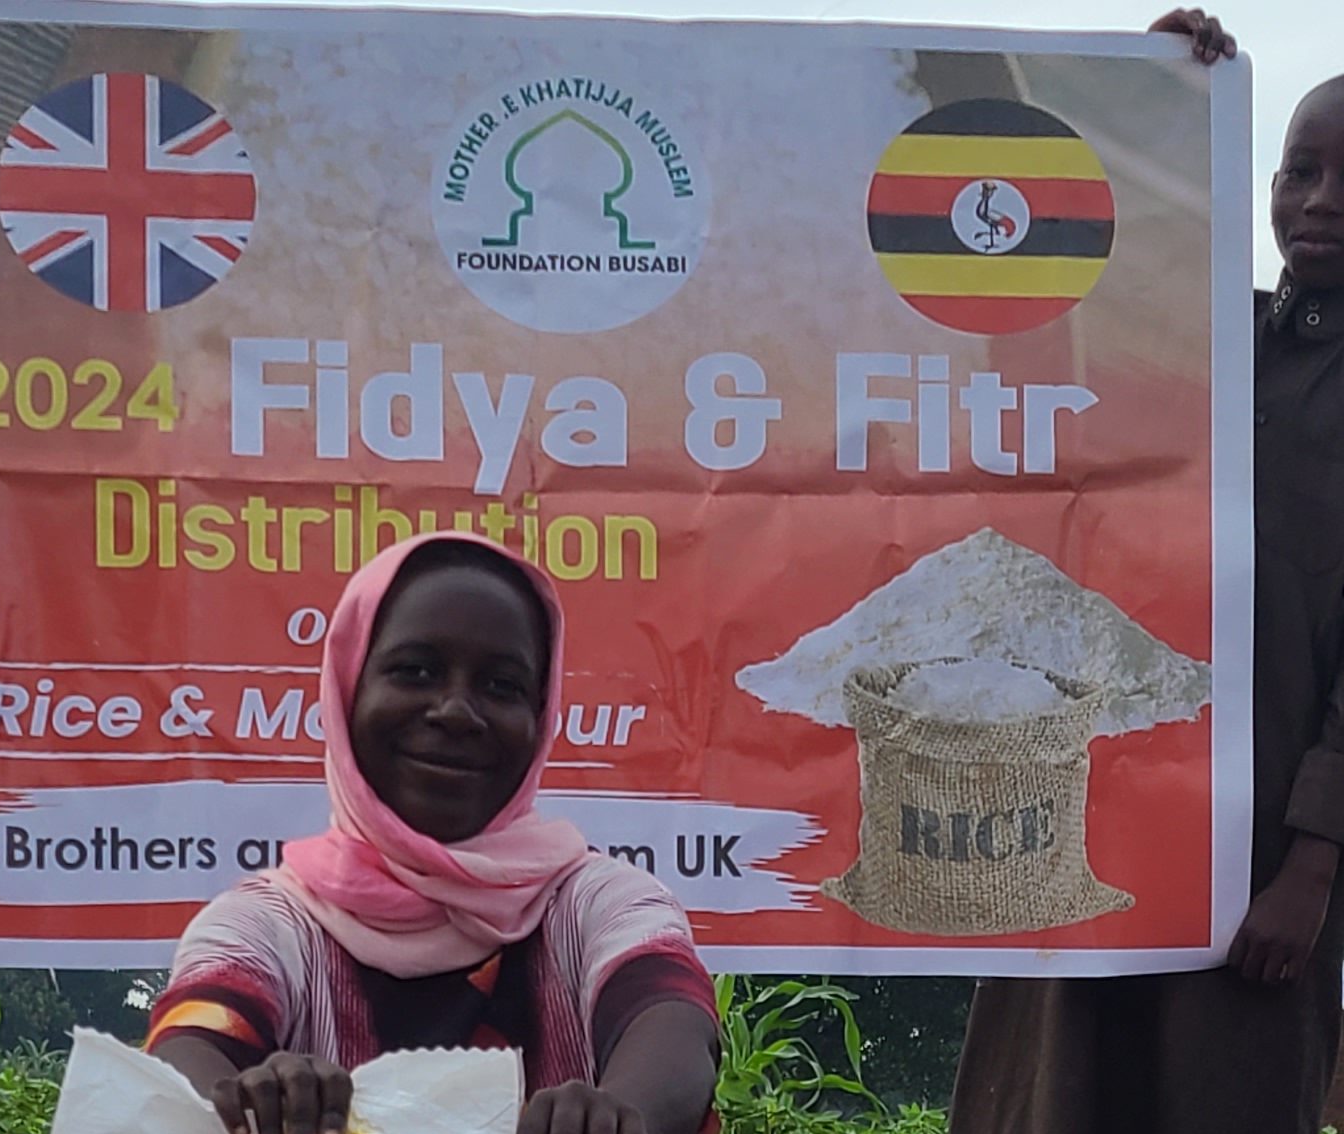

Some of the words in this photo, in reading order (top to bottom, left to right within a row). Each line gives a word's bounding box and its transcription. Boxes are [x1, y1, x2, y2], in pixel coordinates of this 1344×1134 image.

[443, 111, 499, 202] MOTHER
[519, 77, 634, 118] KHATIJJA
[634, 110, 694, 199] MUSLEM
[456, 252, 601, 272] FOUNDATION
[608, 256, 687, 274] BUSABI
[231, 337, 628, 495] Fidya
[684, 352, 782, 470] &
[836, 353, 1099, 477] Fitr
[287, 607, 327, 646] o
[160, 685, 214, 738] &
[4, 826, 217, 871] Brothers
[676, 834, 742, 878] UK
[900, 803, 1055, 863] RICE
